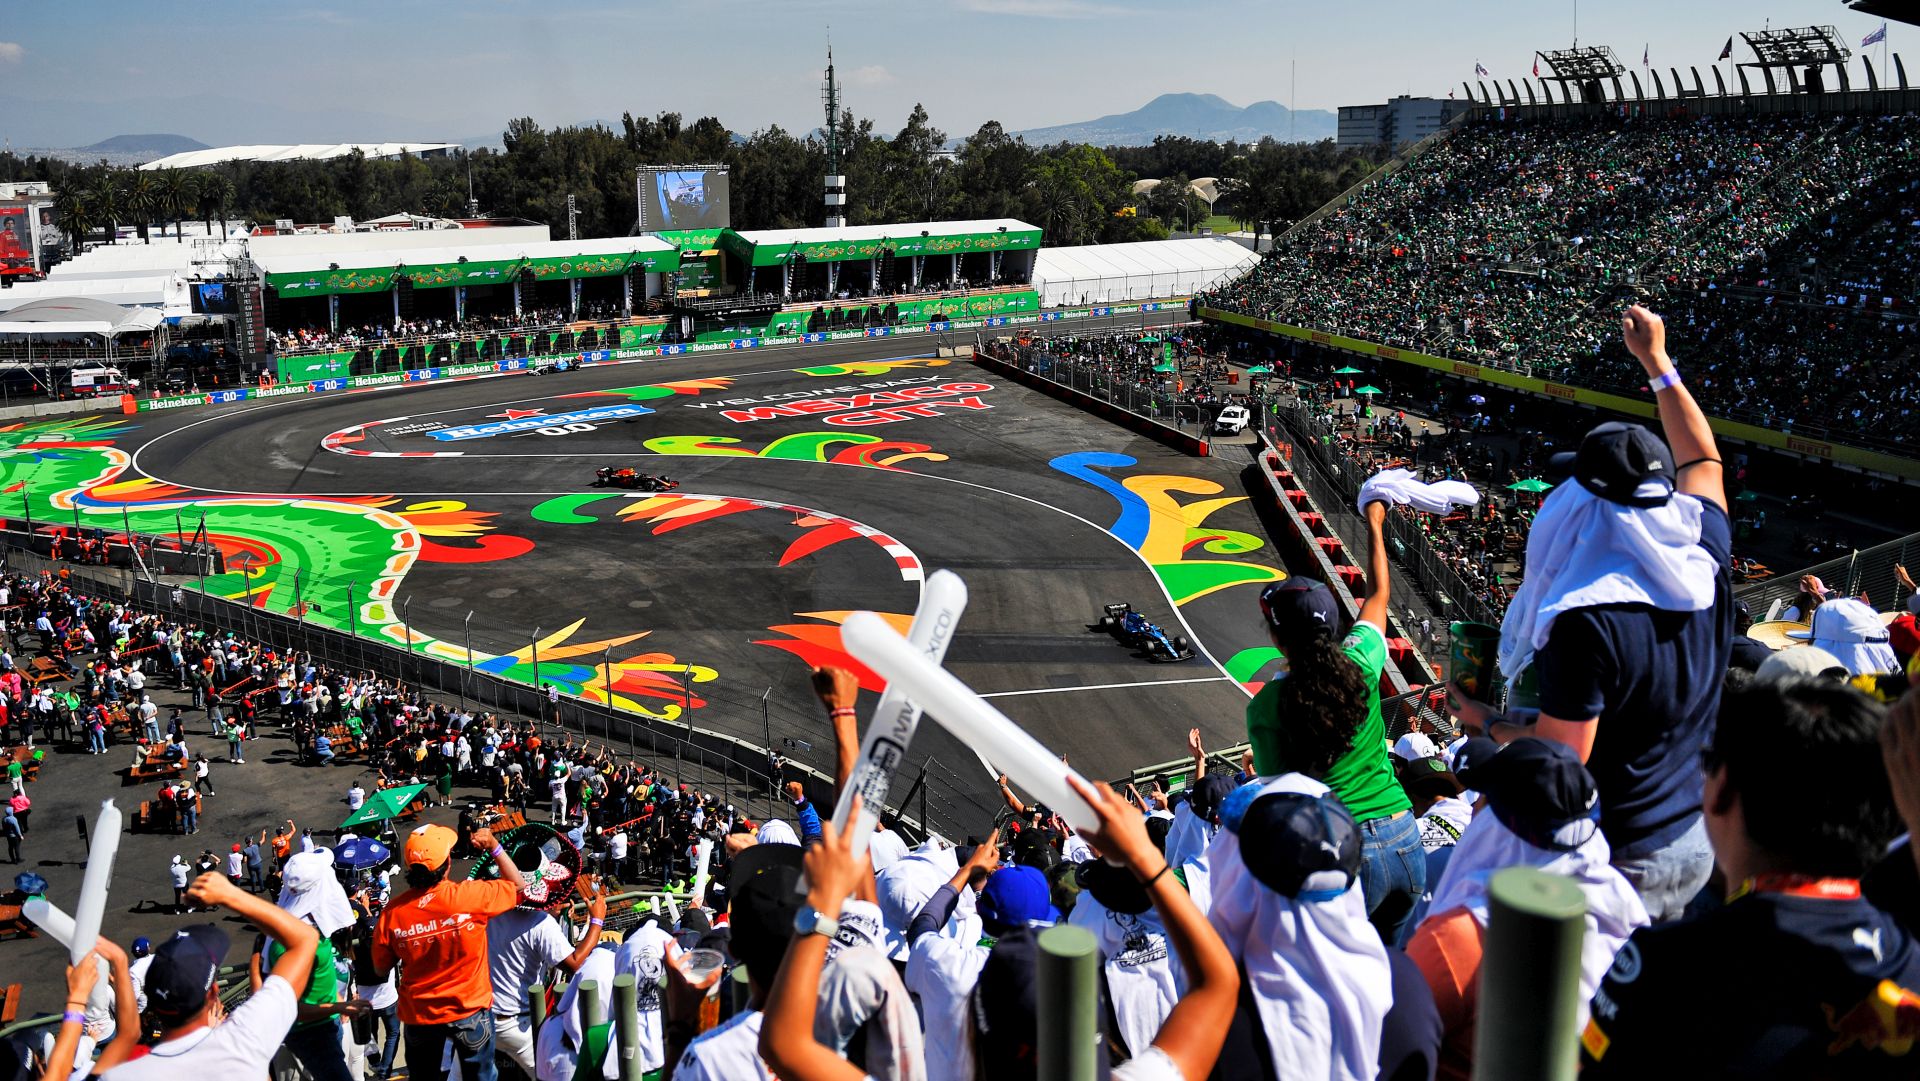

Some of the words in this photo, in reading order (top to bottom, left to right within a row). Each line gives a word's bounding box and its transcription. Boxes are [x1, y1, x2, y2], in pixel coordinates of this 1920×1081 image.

[831, 331, 863, 339] Heineken
[894, 326, 924, 334] Heineken
[692, 342, 728, 352] Heineken
[763, 337, 798, 346] Heineken
[616, 349, 654, 359] Heineken
[447, 364, 491, 376] Heineken
[1454, 363, 1480, 376] PIRELLI
[355, 374, 401, 387] Heineken
[256, 384, 305, 398] Heineken
[684, 386, 860, 410] WELCOME
[862, 375, 953, 389] BACK
[1545, 383, 1576, 399] PIRELLI
[149, 397, 202, 410] Heineken
[719, 382, 995, 424] MEXICO
[822, 396, 996, 427] CITY
[442, 407, 641, 438] Heineken
[1786, 437, 1832, 457] PIRELLI
[394, 924, 415, 938] Red
[416, 920, 438, 934] Bull
